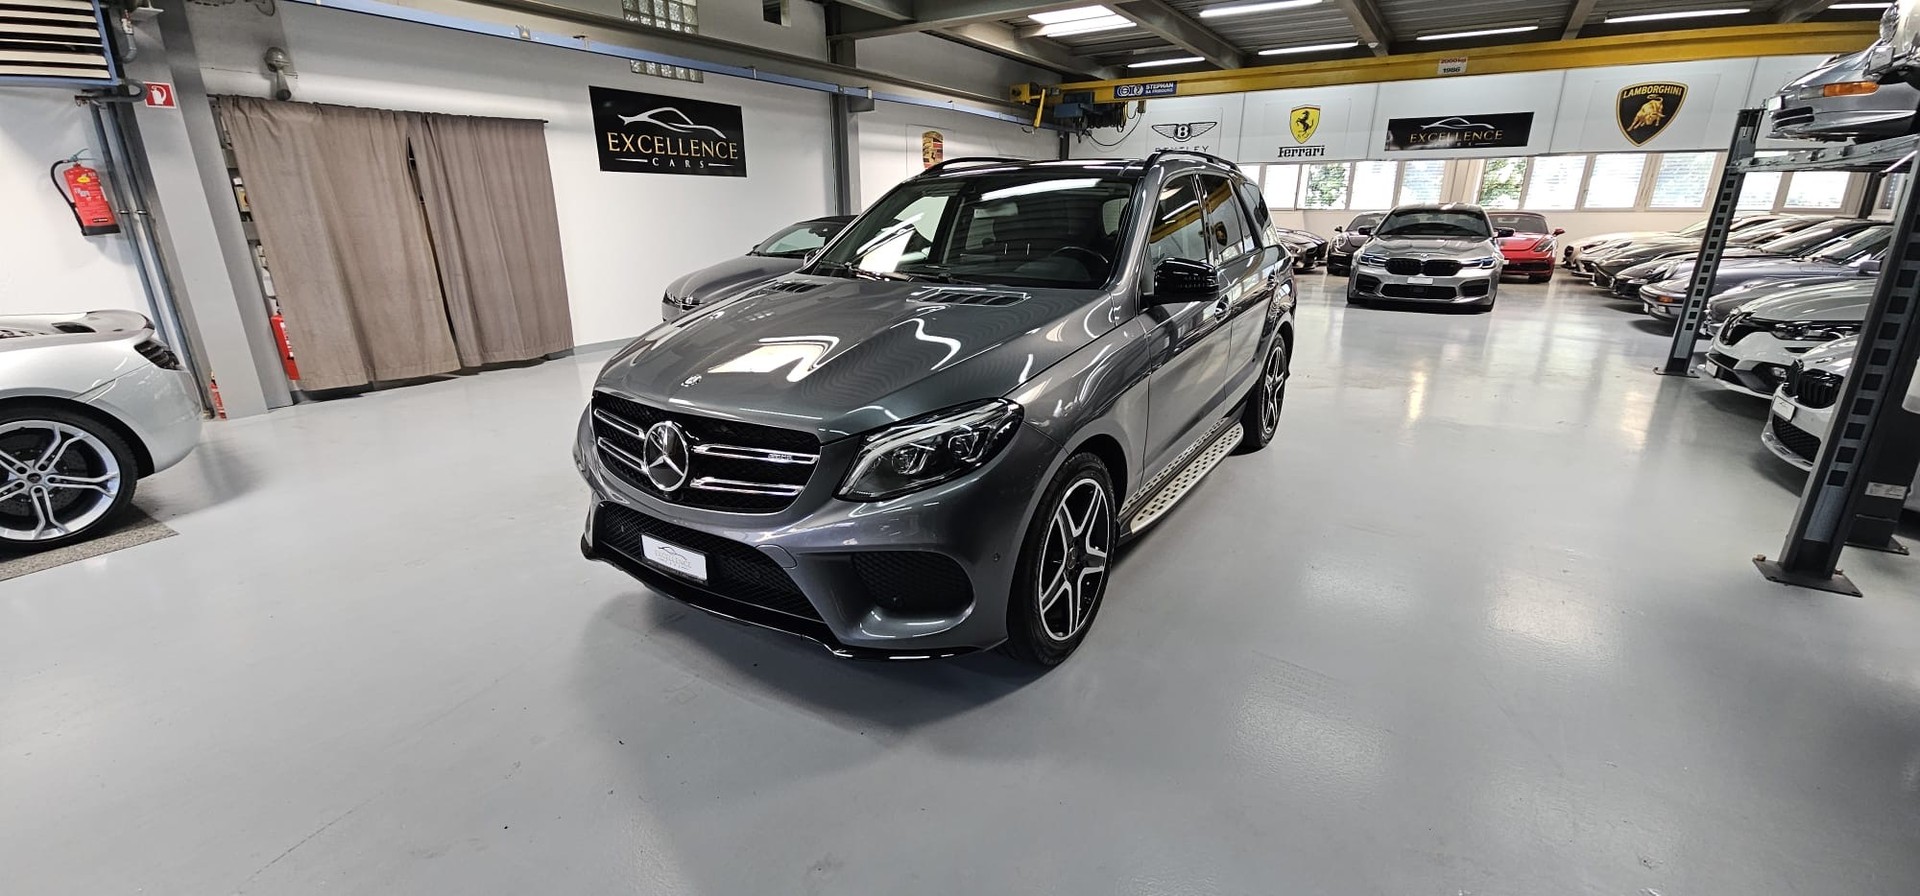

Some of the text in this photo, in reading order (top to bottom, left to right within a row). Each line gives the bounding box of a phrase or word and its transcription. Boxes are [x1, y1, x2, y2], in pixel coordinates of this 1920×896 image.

[1145, 82, 1174, 90] STEPHAN
[1623, 85, 1683, 99] LAMBORGHINI
[1410, 130, 1503, 143] EXCELLENCE
[607, 132, 738, 159] EXCELLENCE
[1278, 145, 1325, 158] Ferrari
[652, 157, 705, 168] CARS
